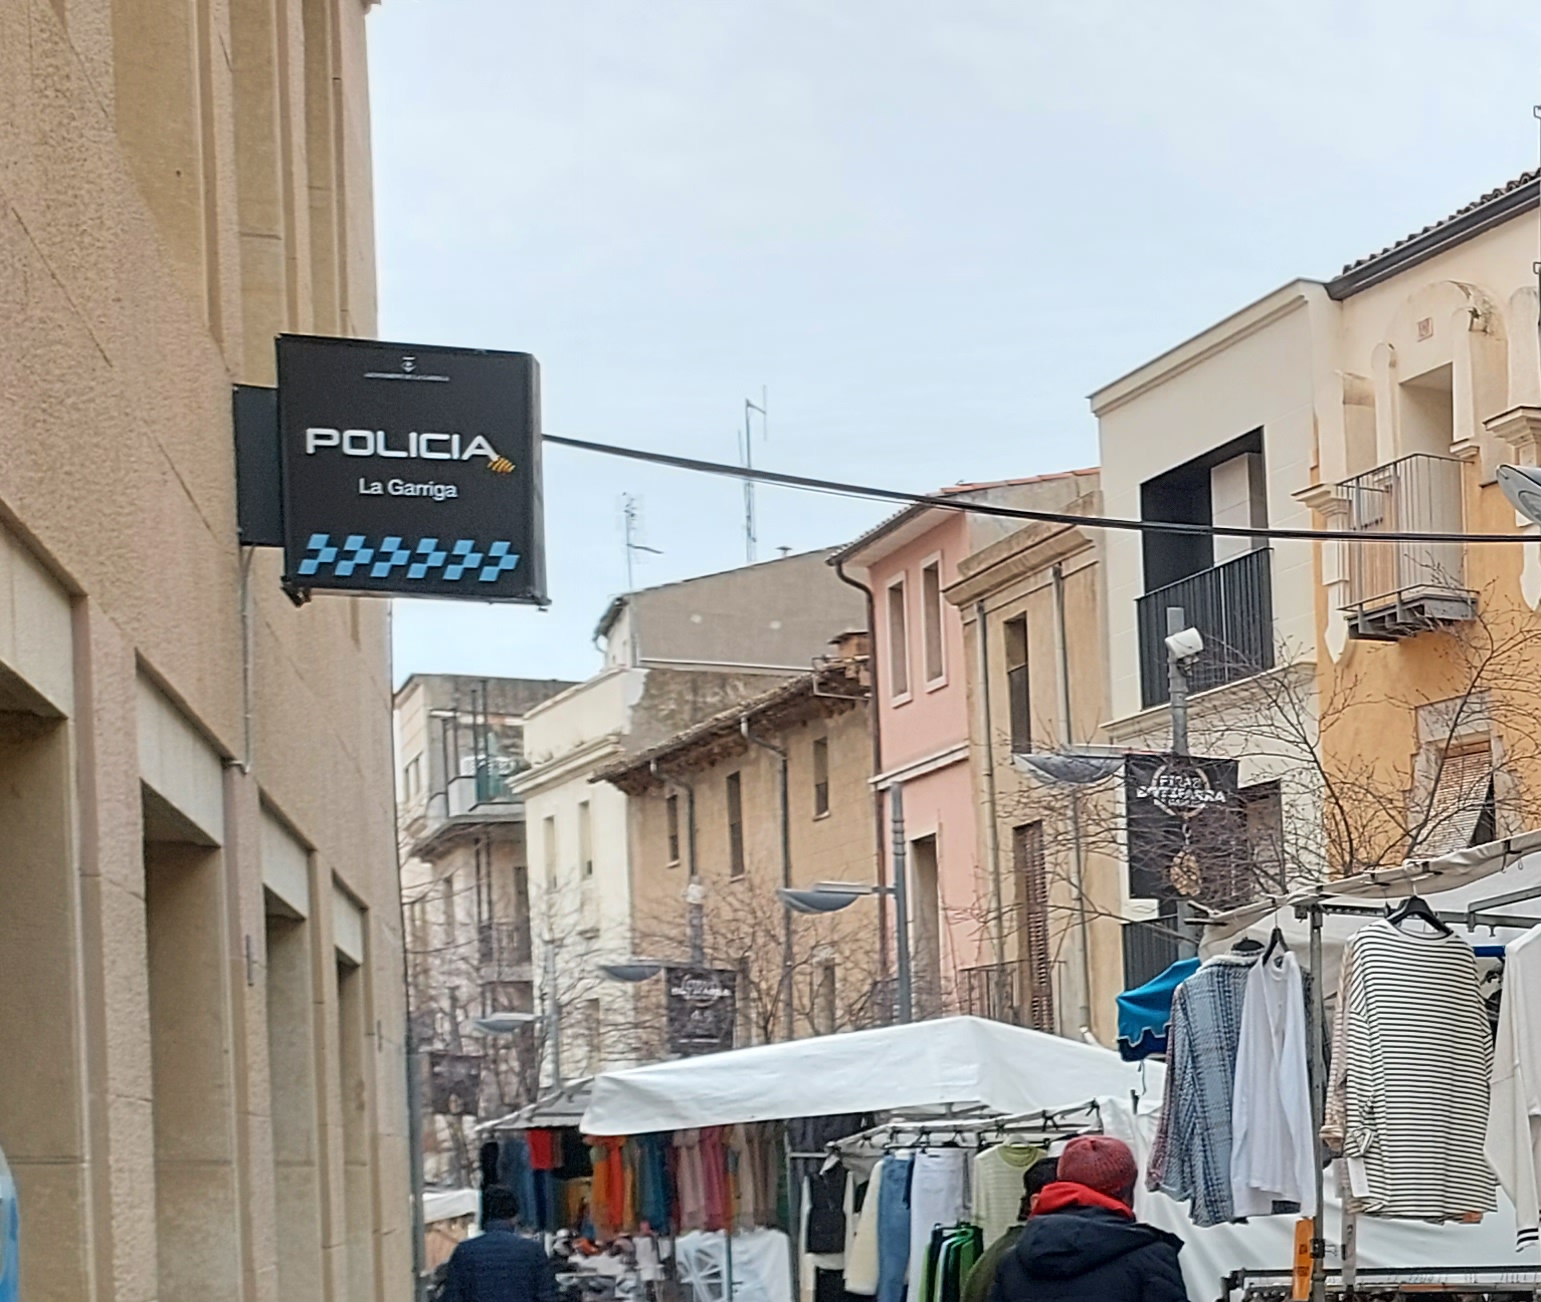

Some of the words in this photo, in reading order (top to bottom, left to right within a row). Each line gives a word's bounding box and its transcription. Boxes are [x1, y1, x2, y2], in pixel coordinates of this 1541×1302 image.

[306, 428, 499, 461] POLICIA
[359, 478, 384, 495] La
[387, 479, 458, 501] Garriga
